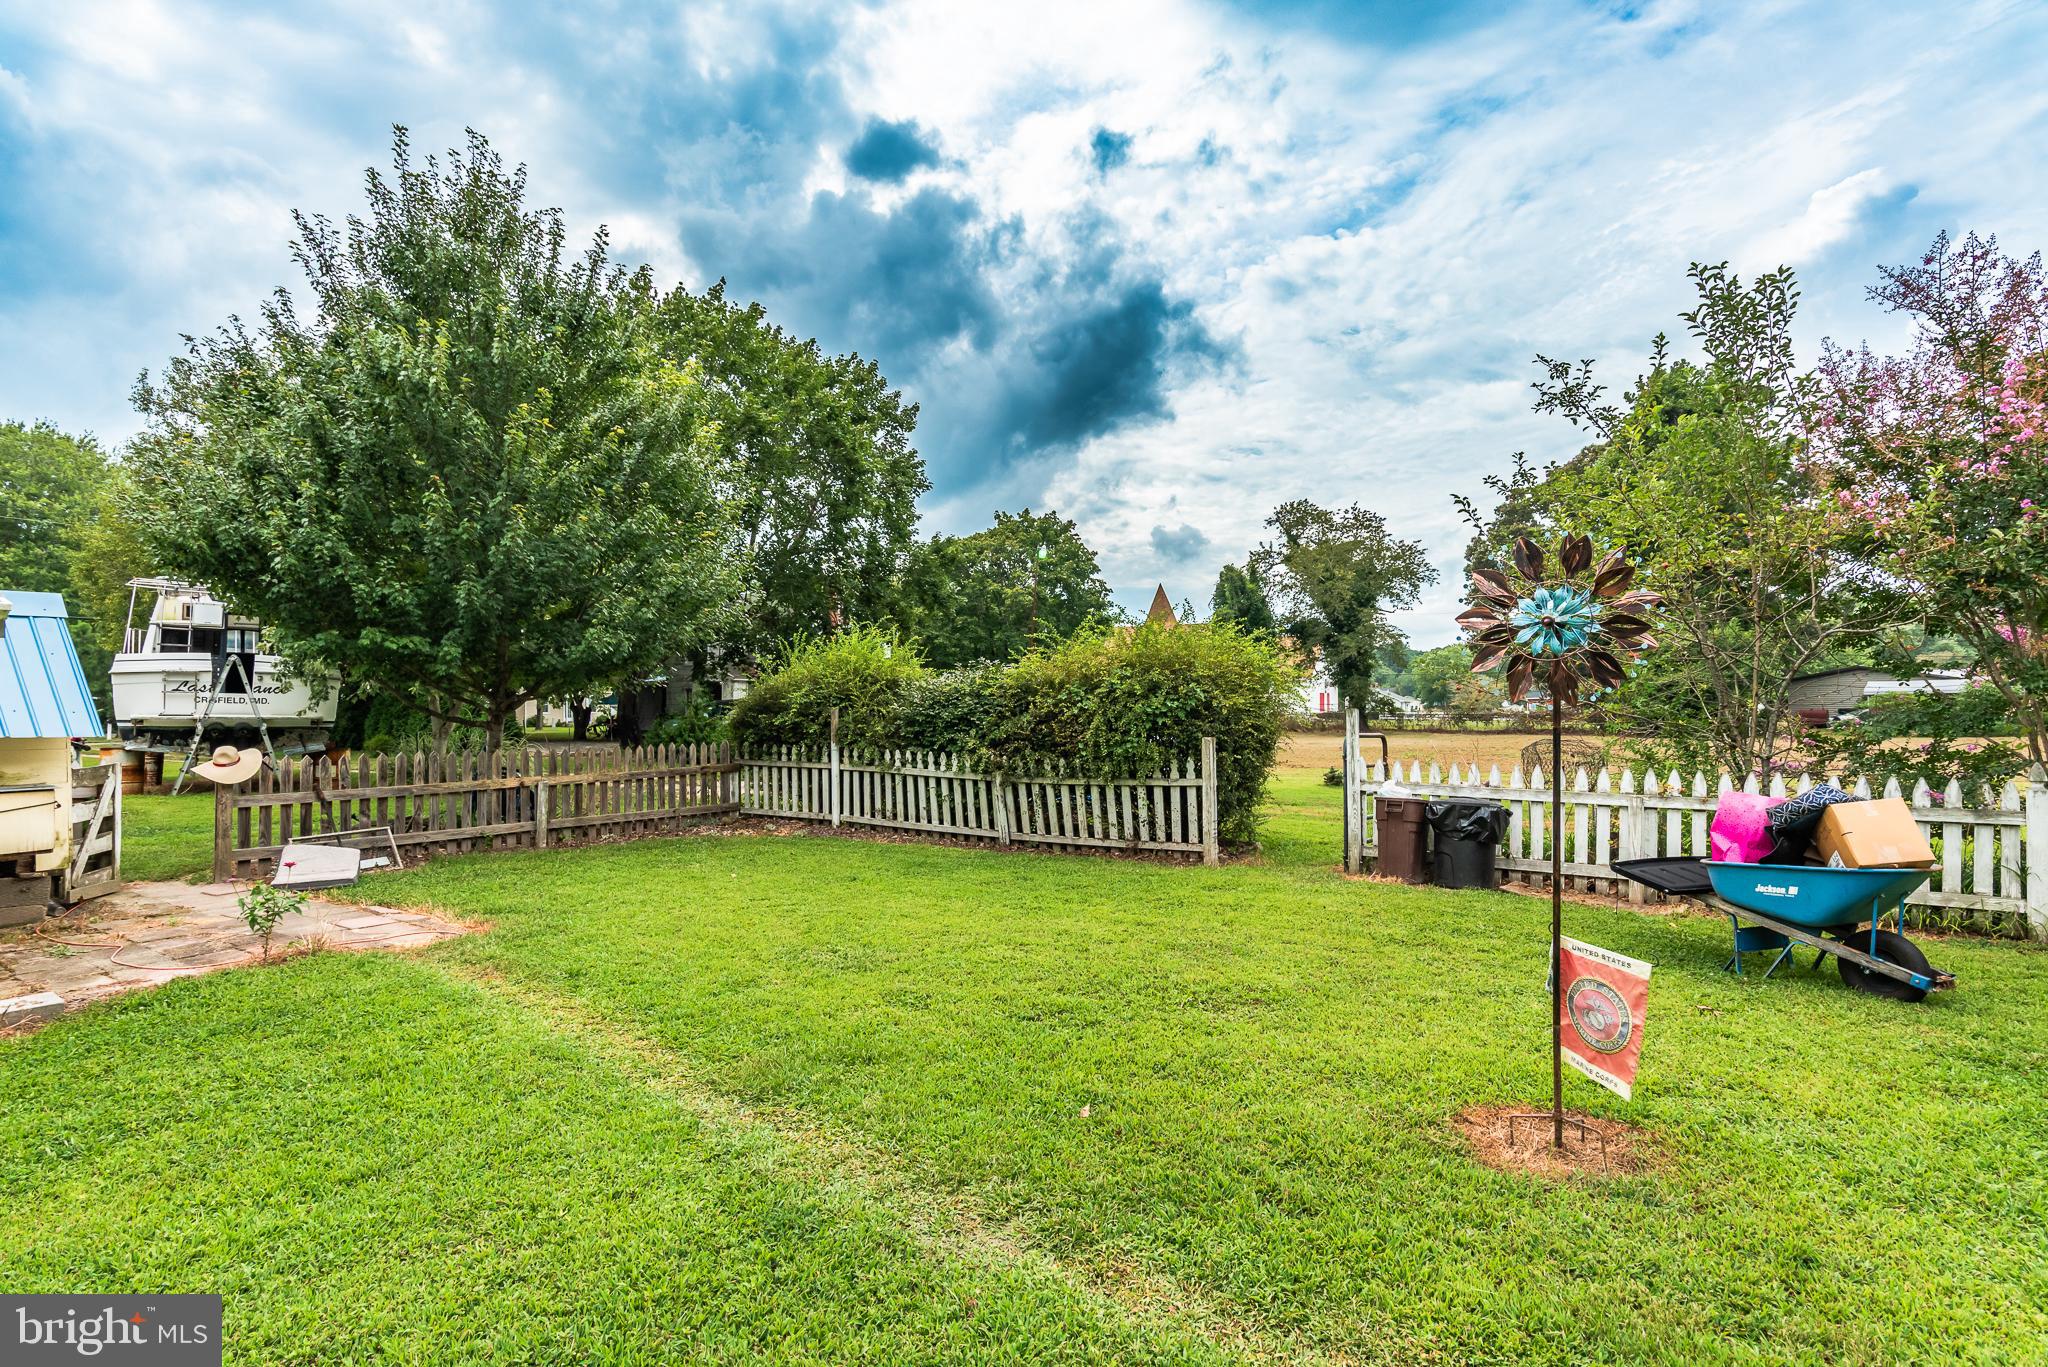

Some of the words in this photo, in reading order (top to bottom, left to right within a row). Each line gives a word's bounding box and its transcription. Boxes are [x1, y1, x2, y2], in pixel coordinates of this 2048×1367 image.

[1755, 884, 1786, 894] Jackson
[1571, 944, 1599, 958] UNITED
[1601, 953, 1632, 969] STATES
[1571, 1056, 1593, 1075] MARINE
[1595, 1071, 1618, 1088] CORPS
